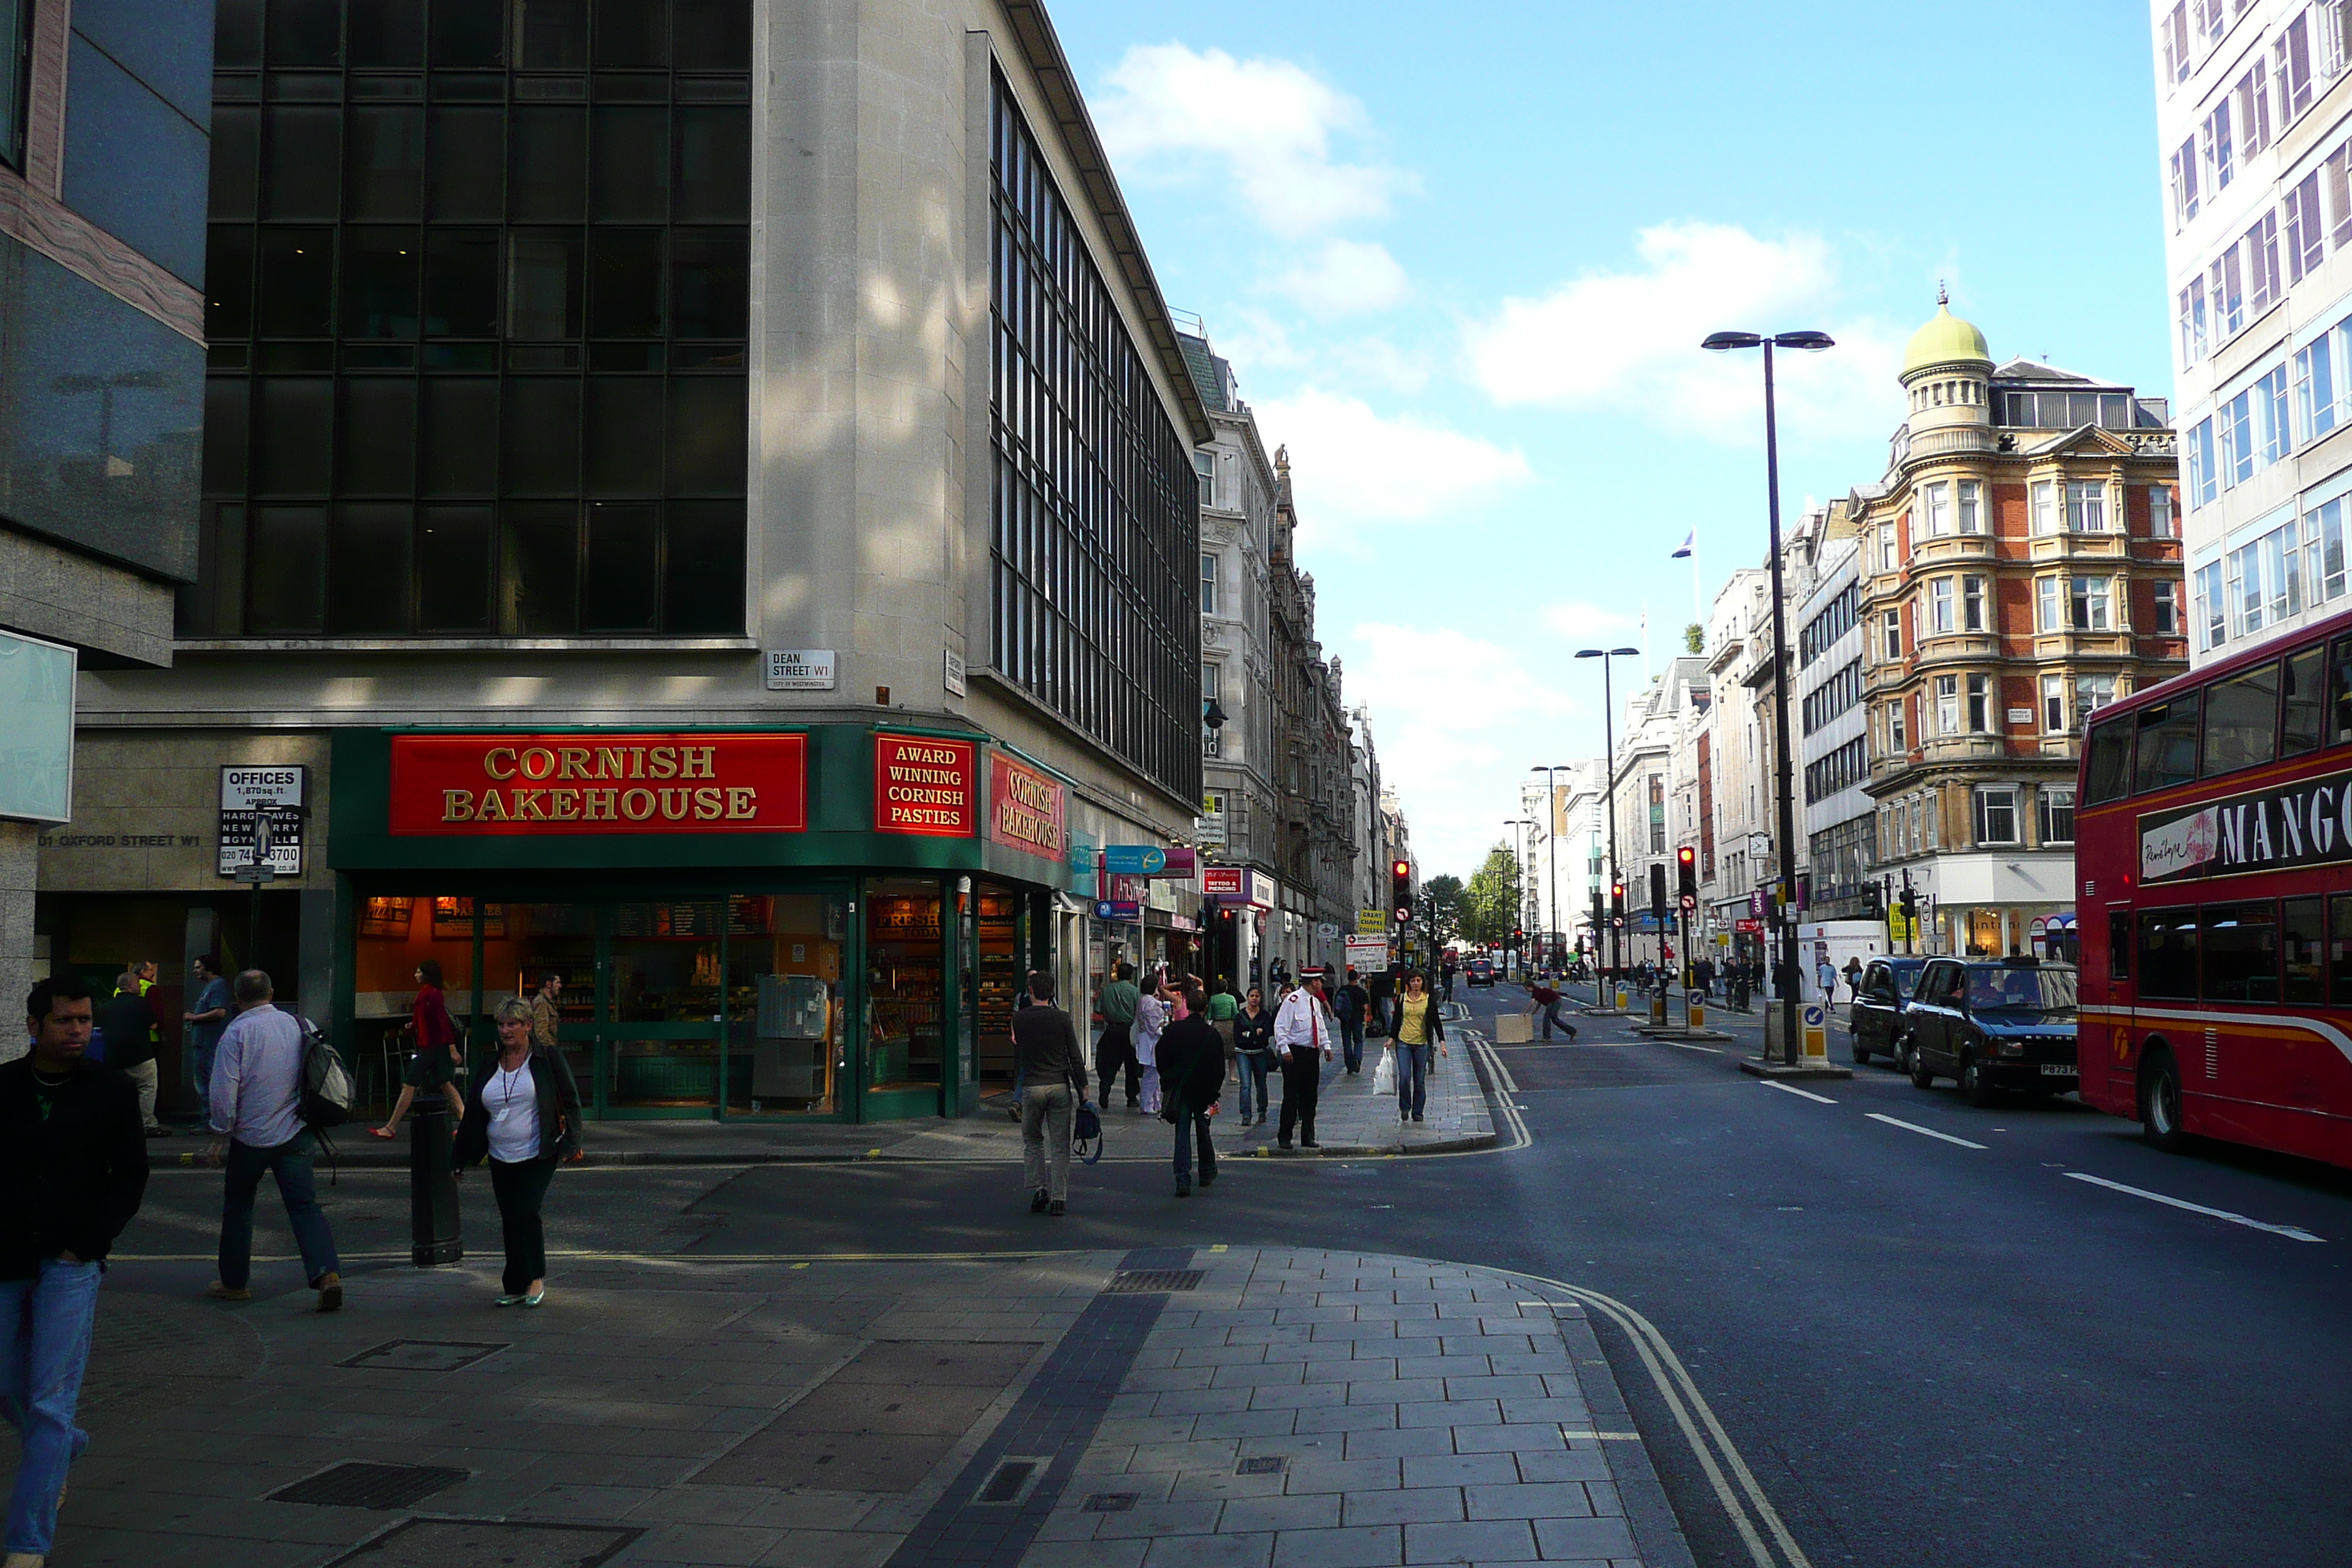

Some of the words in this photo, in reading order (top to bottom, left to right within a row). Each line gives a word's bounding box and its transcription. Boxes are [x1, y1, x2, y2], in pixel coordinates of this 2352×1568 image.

[773, 653, 800, 663] DEAN
[773, 666, 810, 676] STREET
[814, 666, 828, 676] W1
[896, 747, 956, 764] AWARD
[484, 747, 716, 780] CORNISH
[229, 772, 295, 785] OFFICES
[889, 766, 962, 785] WINNING
[889, 786, 964, 805] CORNISH
[1010, 771, 1051, 815] CORNISH
[442, 787, 758, 821] BAKEHOUSE
[891, 807, 960, 825] PASTIES
[1000, 803, 1058, 851] BAKEHOUSE
[37, 835, 53, 846] 01
[59, 835, 116, 846] OXFORD
[121, 835, 175, 846] STREET
[180, 835, 200, 846] W1
[232, 836, 289, 844] GYNLL
[222, 851, 236, 859] 020
[271, 849, 297, 861] 3700
[878, 914, 940, 927] FRESH
[903, 929, 940, 938] TODA
[1891, 925, 1915, 934] COLLE
[2043, 1066, 2068, 1074] P873
